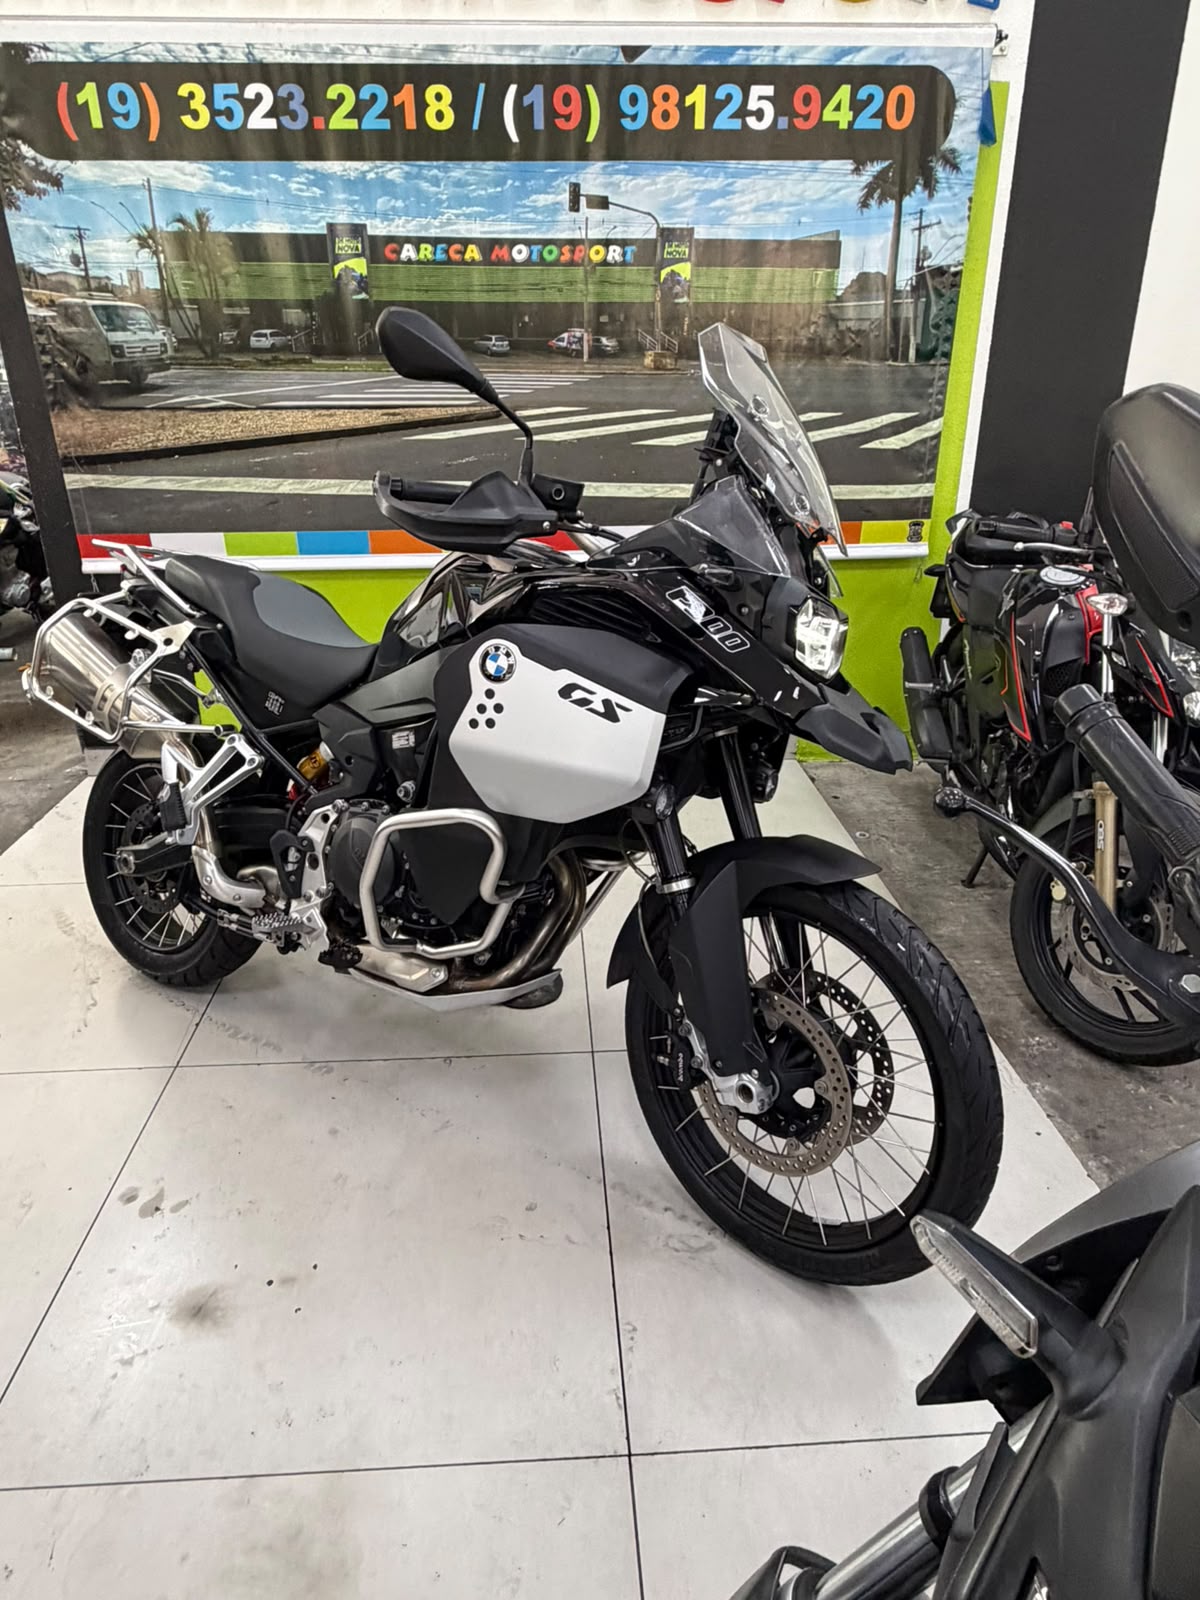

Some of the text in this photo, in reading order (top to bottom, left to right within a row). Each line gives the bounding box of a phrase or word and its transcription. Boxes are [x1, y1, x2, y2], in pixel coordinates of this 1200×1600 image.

[56, 81, 916, 143] (19) 3523.2218 / (19) 98125.9420
[384, 243, 637, 263] CARECA MOTOSPORT
[557, 682, 633, 723] GS
